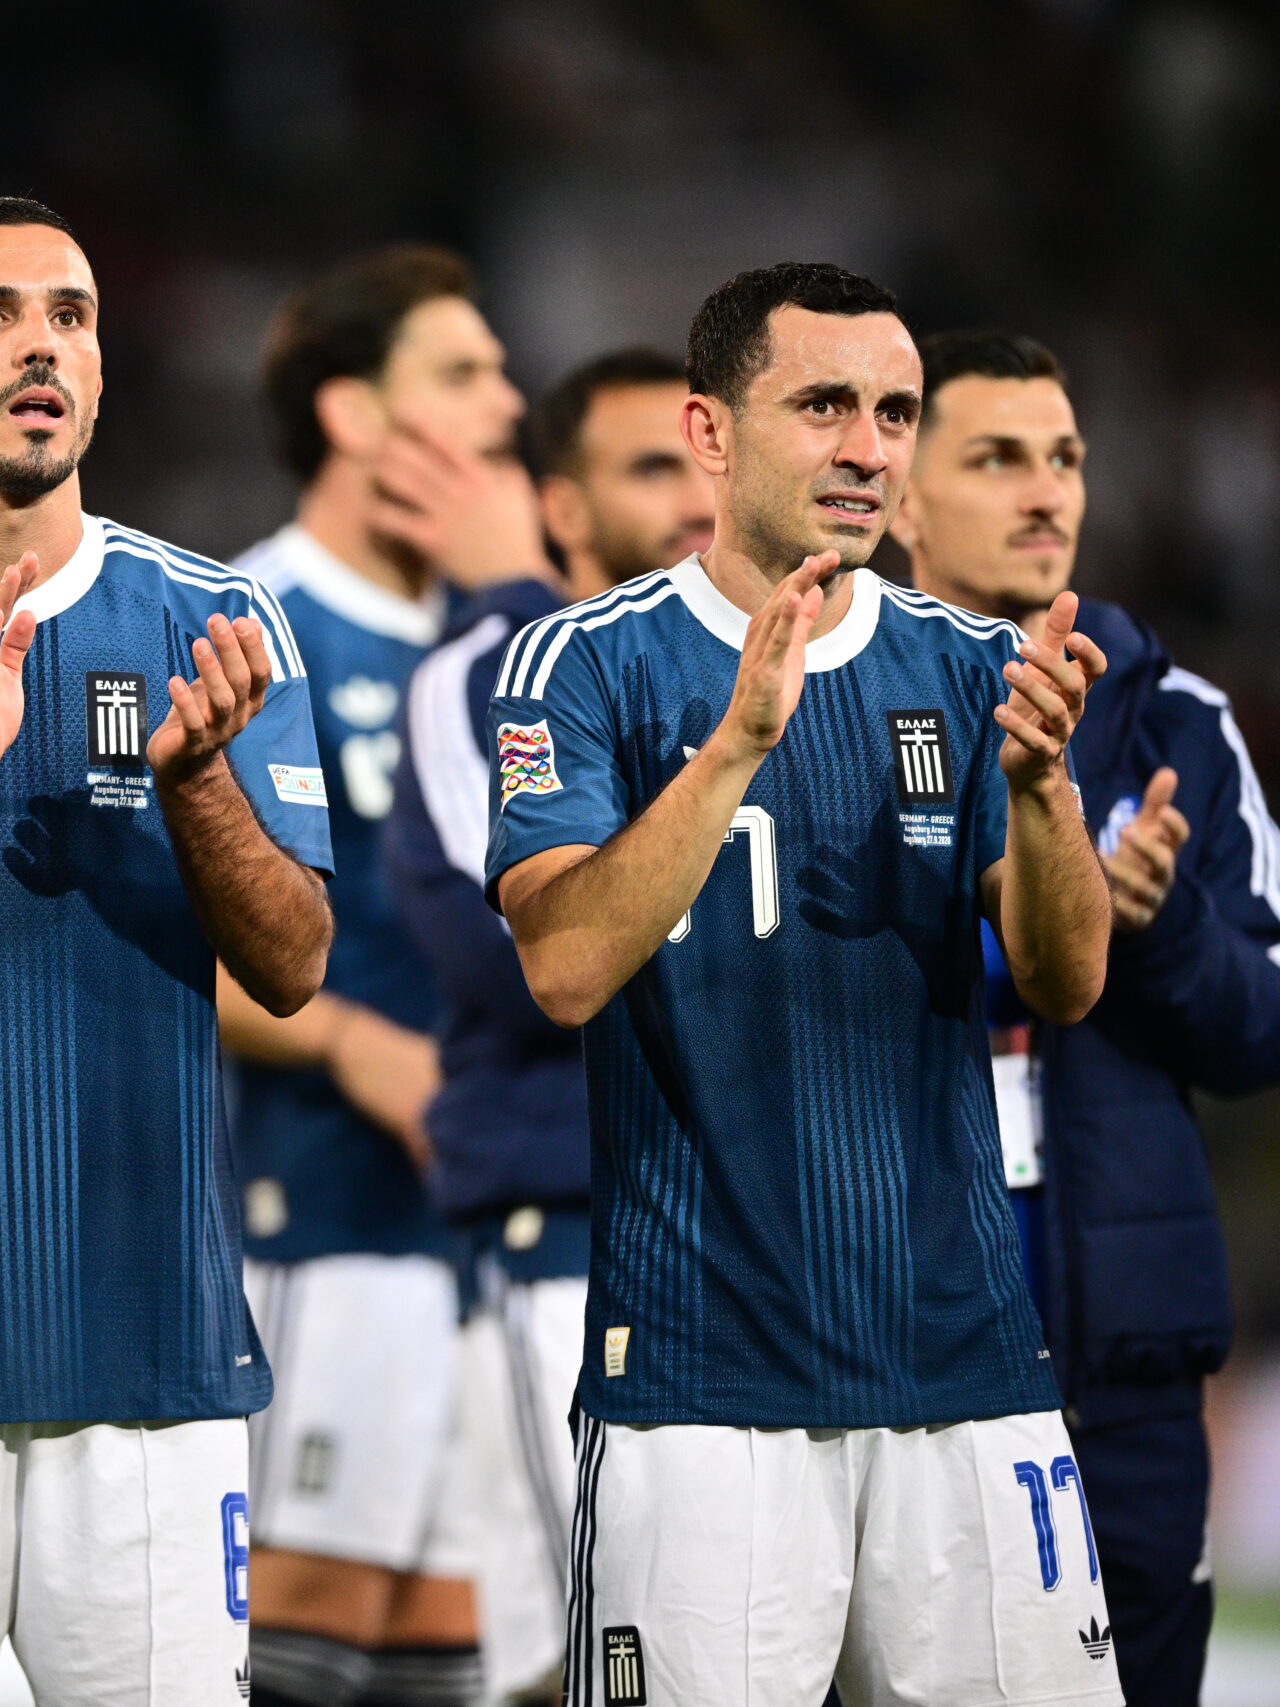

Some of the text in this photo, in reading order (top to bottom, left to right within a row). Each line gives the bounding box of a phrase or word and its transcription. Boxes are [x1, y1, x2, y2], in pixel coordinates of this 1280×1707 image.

[95, 680, 137, 691] ΕΛΛΑΣ
[896, 719, 936, 729] ΕΛΛΑΣ
[272, 767, 289, 775] UEFA
[125, 777, 151, 787] GREECE
[125, 787, 144, 796] Arena
[930, 816, 954, 824] GREECE
[667, 805, 780, 944] 7
[1013, 1455, 1099, 1592] 17
